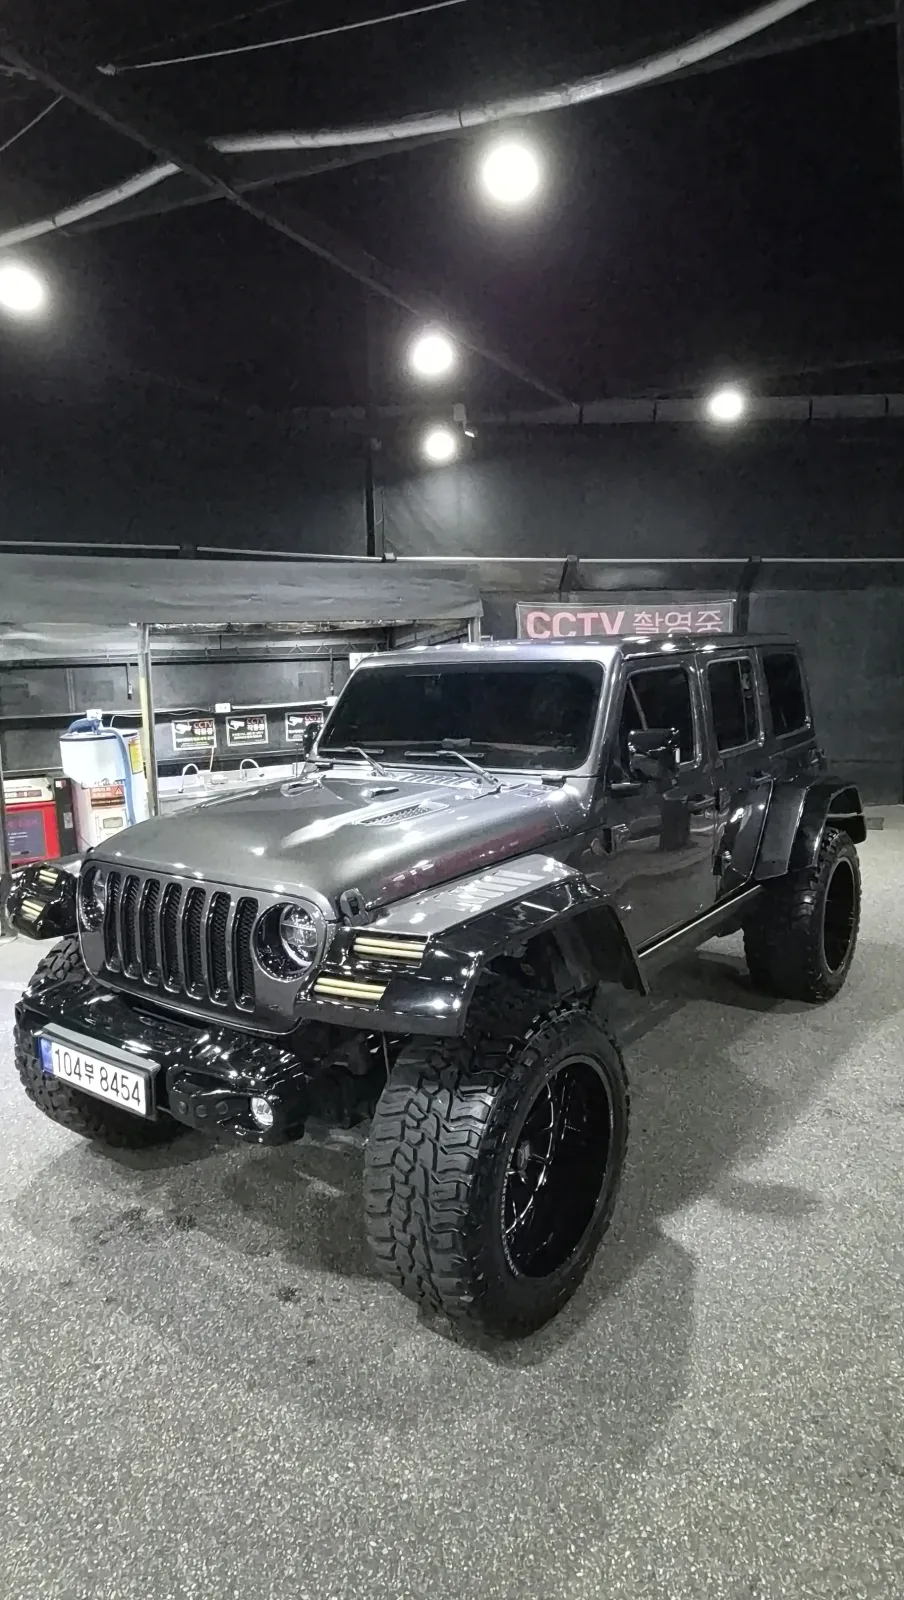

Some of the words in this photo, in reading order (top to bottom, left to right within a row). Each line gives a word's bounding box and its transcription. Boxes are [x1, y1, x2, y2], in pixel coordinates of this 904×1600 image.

[526, 611, 625, 639] CCTV
[54, 1048, 94, 1084] 104부
[99, 1066, 141, 1107] 8454
